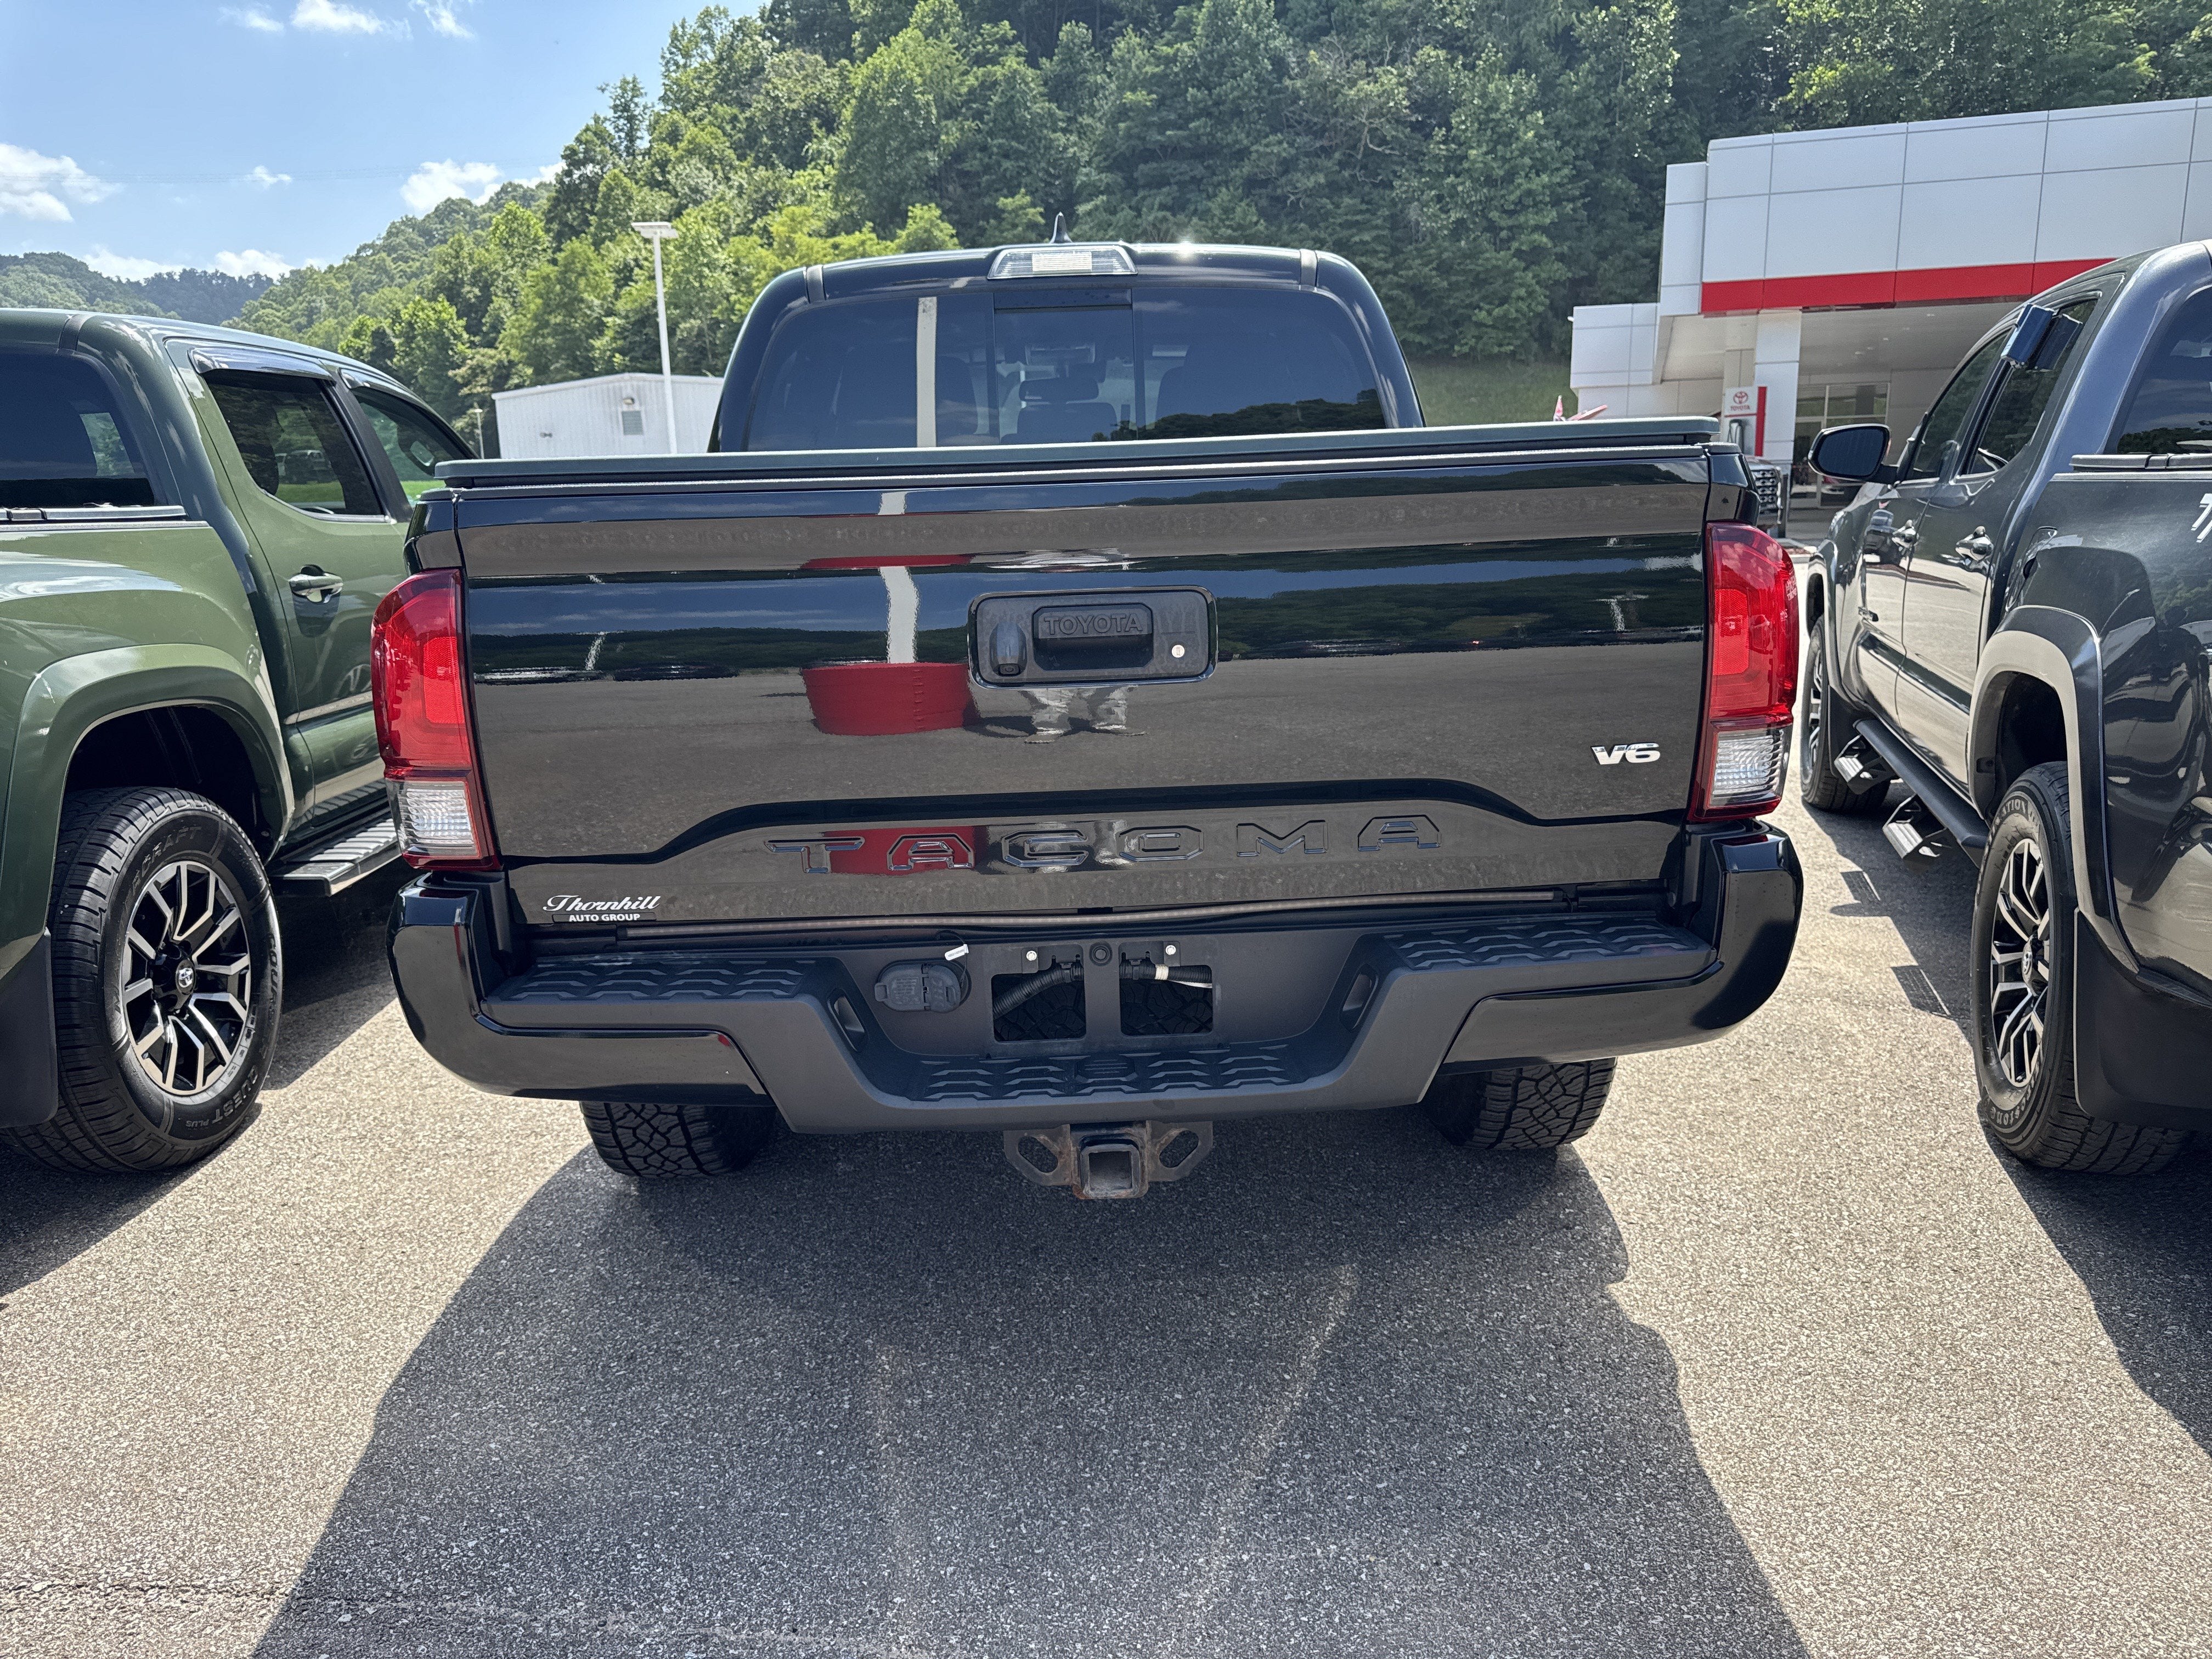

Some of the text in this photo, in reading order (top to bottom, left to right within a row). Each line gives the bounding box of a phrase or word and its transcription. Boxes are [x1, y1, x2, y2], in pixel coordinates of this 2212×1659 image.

[1044, 613, 1143, 635] TOYOTA
[1592, 743, 1661, 765] V6
[764, 815, 1441, 873] TACOMA
[543, 895, 661, 911] Thornhill
[569, 913, 641, 922] AUTO GROUP
[212, 1065, 258, 1124] QUEST
